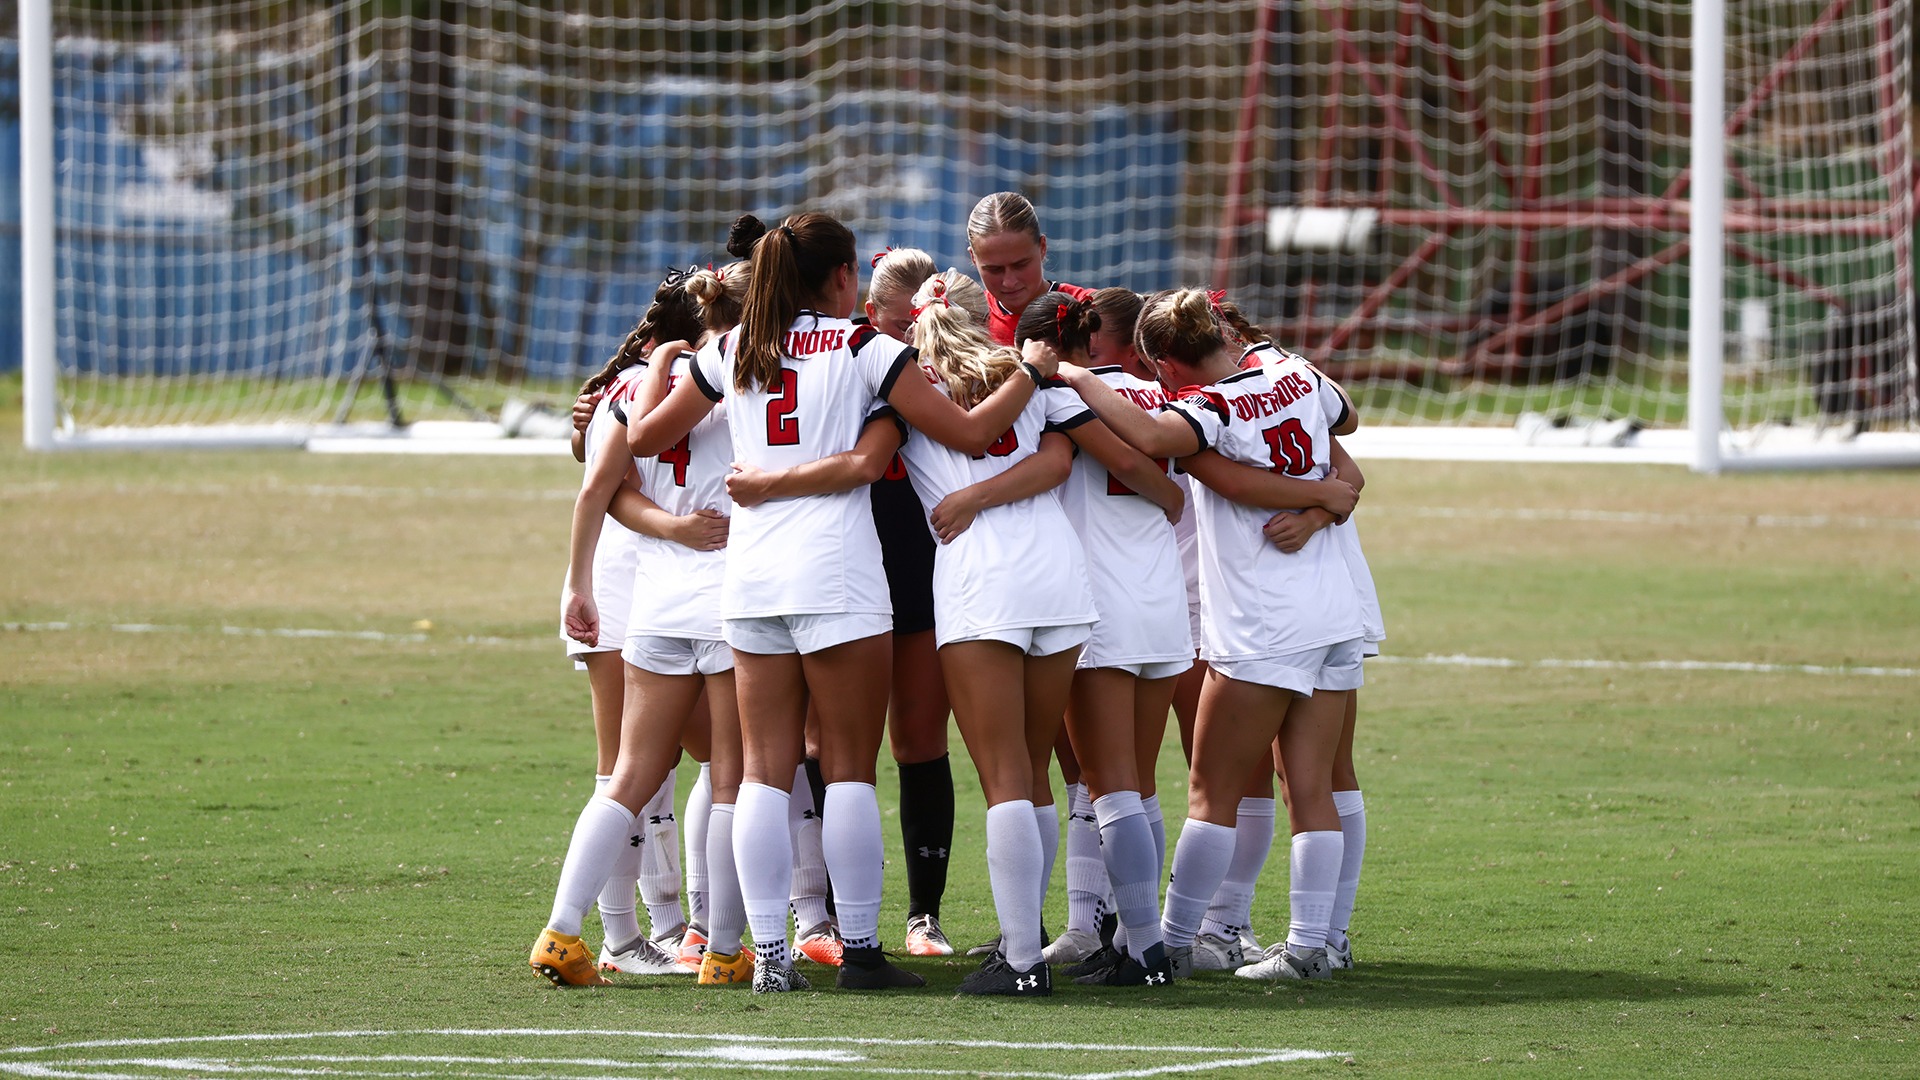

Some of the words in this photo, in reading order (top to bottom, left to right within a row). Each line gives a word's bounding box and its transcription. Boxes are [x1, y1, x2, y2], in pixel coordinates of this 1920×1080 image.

[766, 368, 800, 446] 2
[658, 431, 692, 488] 4
[1261, 417, 1316, 476] 10
